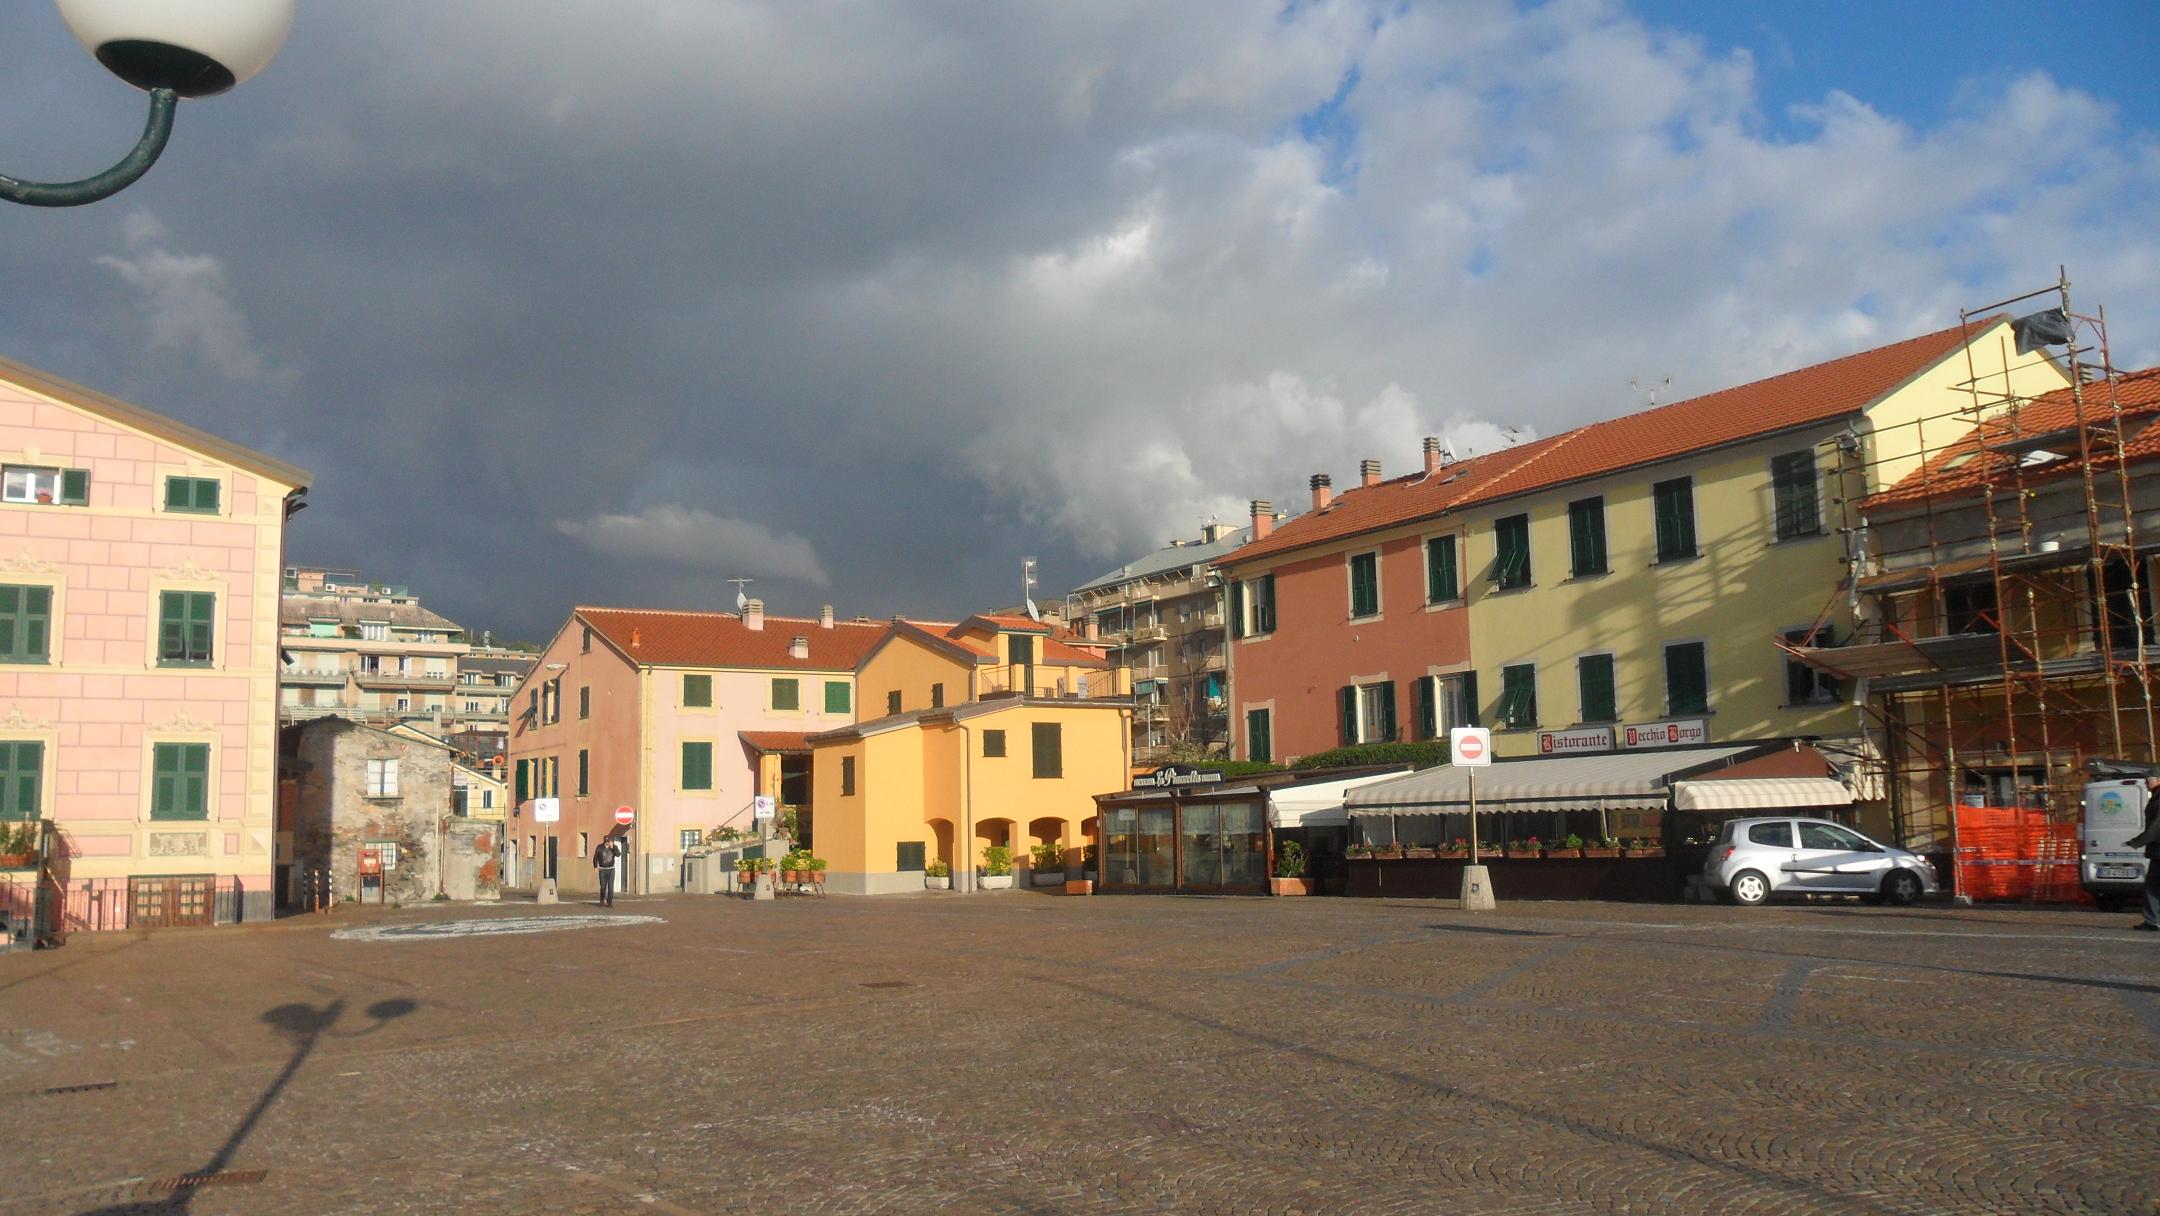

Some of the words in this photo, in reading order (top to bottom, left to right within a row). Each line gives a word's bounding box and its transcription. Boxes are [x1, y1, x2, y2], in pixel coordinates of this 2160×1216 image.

[1542, 734, 1608, 753] Ristorante
[1627, 727, 1665, 746] Vecchio
[1668, 725, 1702, 743] Borgo
